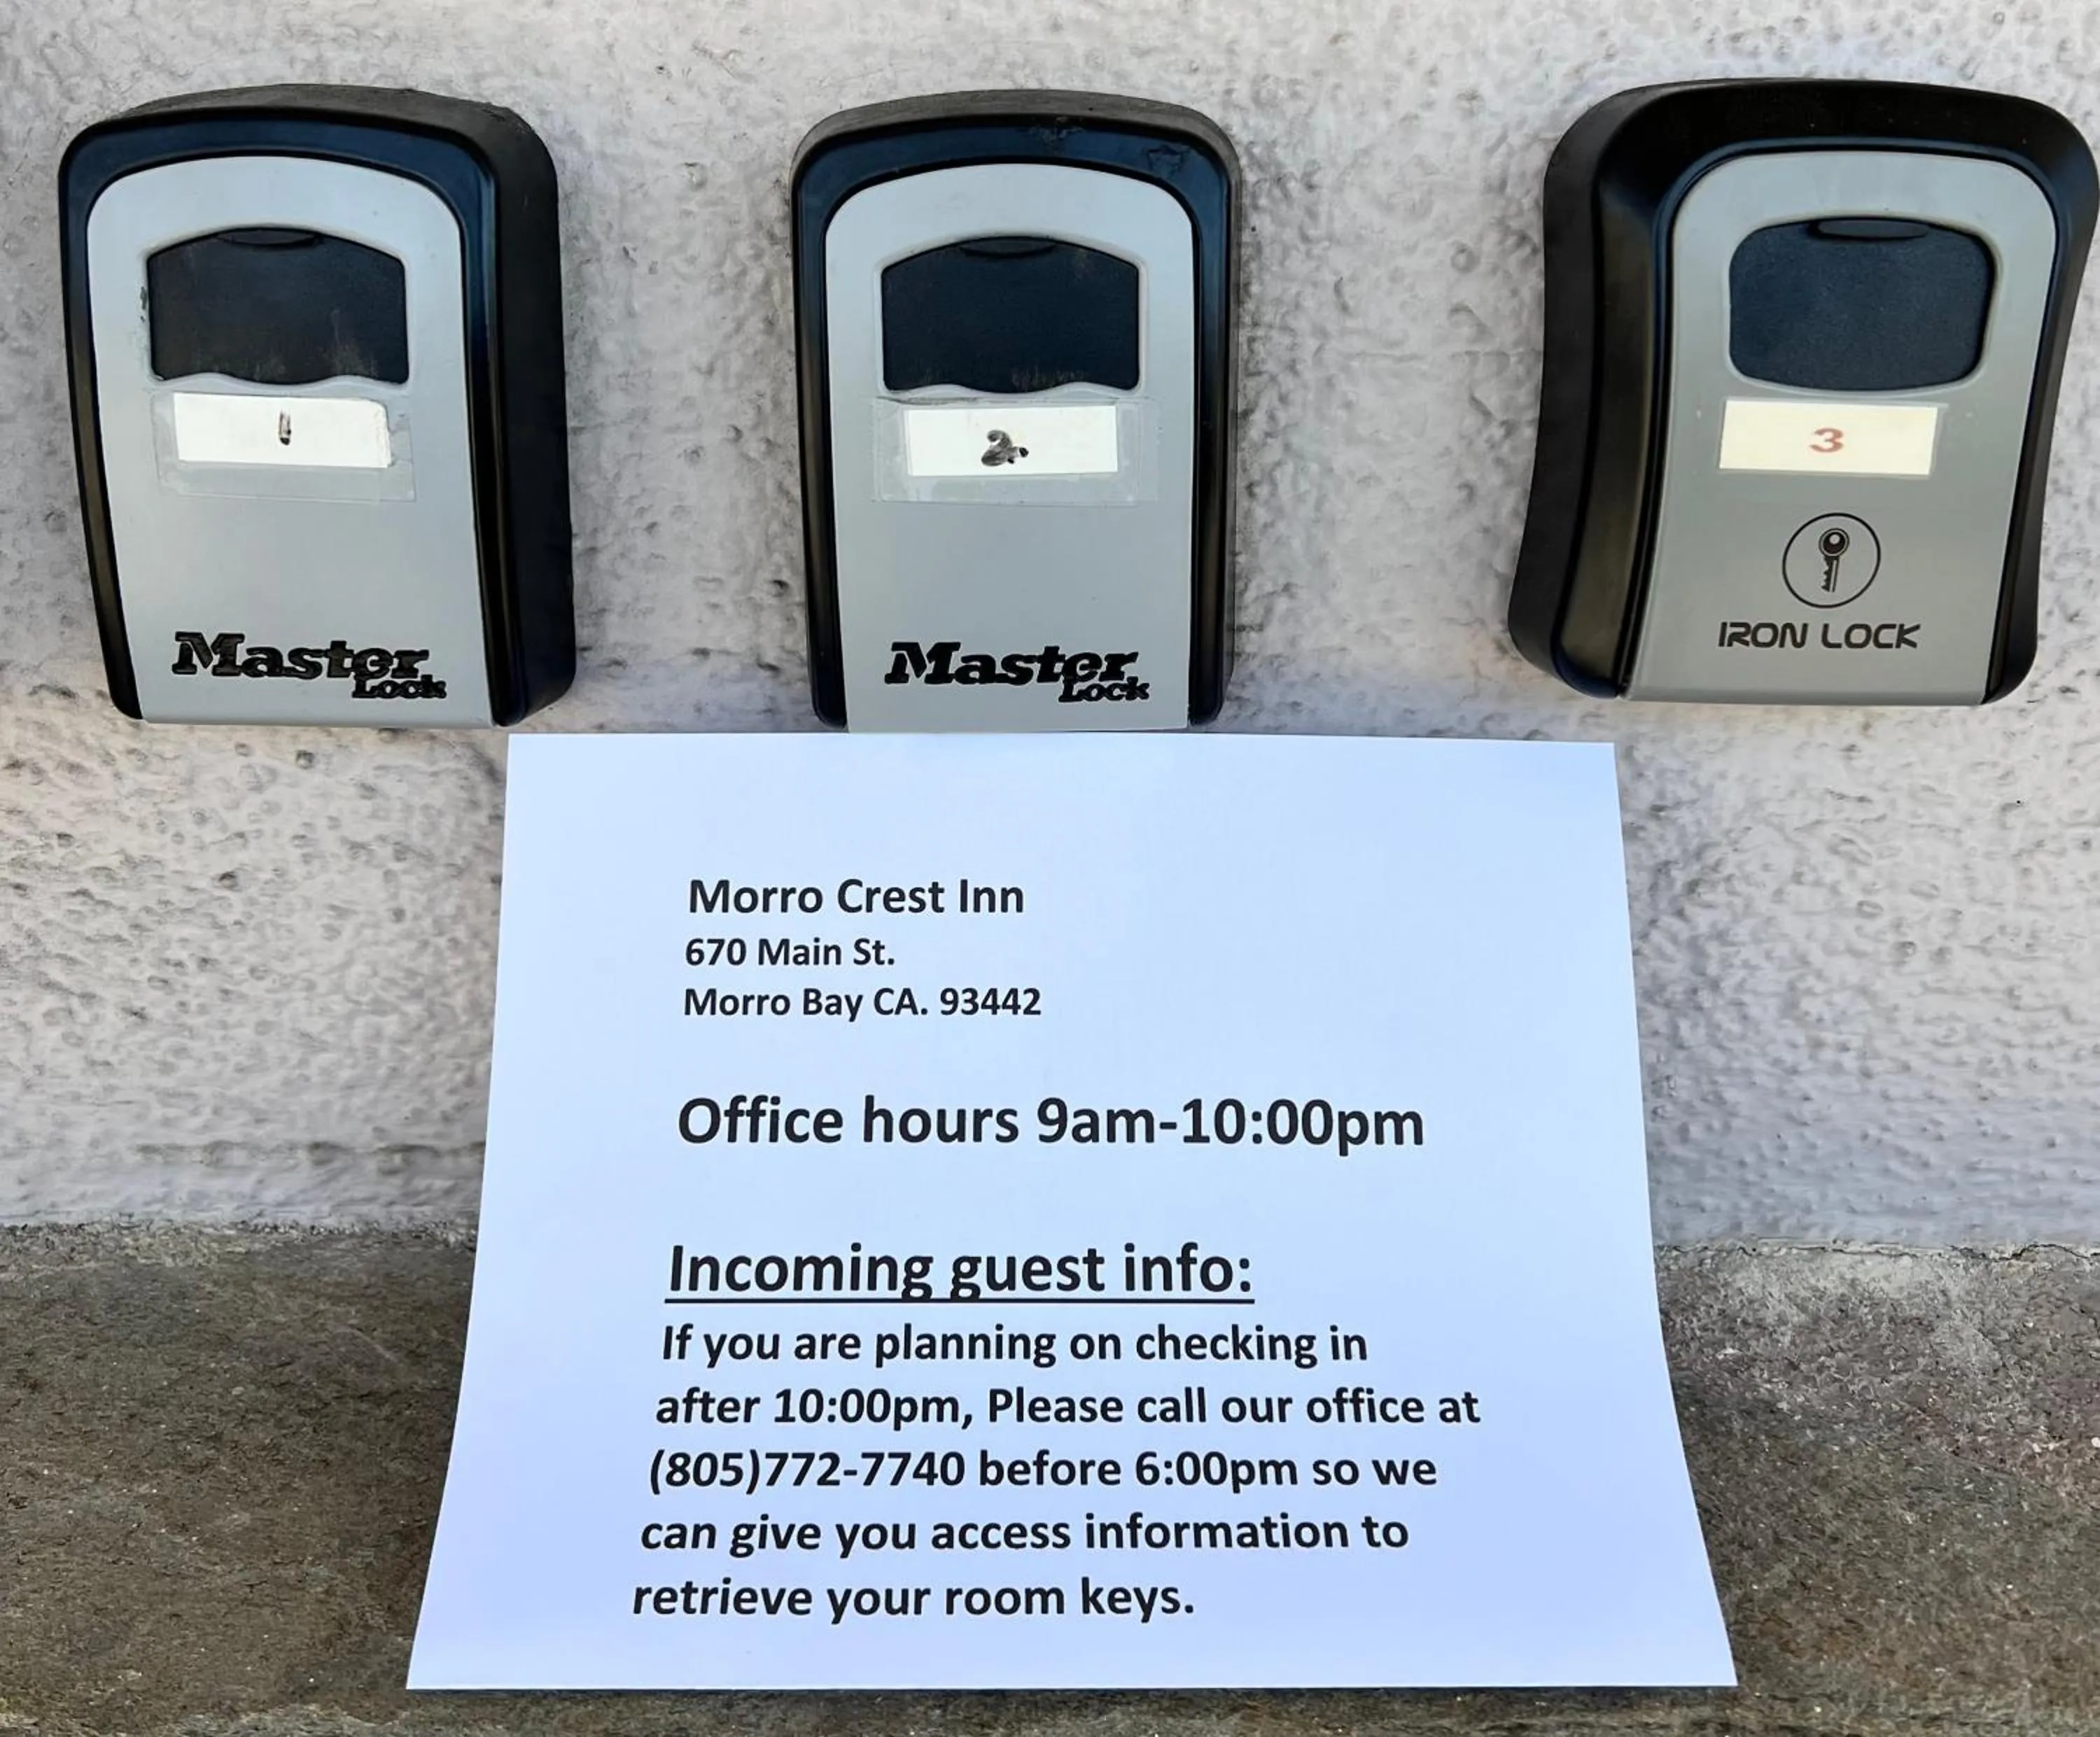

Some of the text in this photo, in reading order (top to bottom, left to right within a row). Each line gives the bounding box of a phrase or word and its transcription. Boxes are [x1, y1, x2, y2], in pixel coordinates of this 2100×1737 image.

[981, 429, 1029, 467] 2
[1809, 427, 1844, 453] 3
[172, 631, 430, 680] Master
[1717, 621, 1921, 649] IRON LOCK
[884, 642, 1139, 685] Master
[351, 674, 448, 699] Lock
[1058, 676, 1150, 703] Lock
[689, 878, 1024, 914] Morro Crest Inn
[685, 936, 895, 966] 670 Main St.
[683, 987, 1042, 1023] Morro Bay CA. 93442
[678, 1093, 1424, 1158] Office hours 9am-10:00pm
[668, 1241, 1252, 1301] Incoming guest info:
[662, 1322, 1368, 1370] If you are planning on checking in
[655, 1385, 1482, 1433] after 10:00pm, Please call our office at
[650, 1448, 1438, 1496] (805)772-7740 before 6:00pm so we
[640, 1510, 1409, 1560] can give you access information to
[632, 1575, 1194, 1626] retrieve your room keys.
